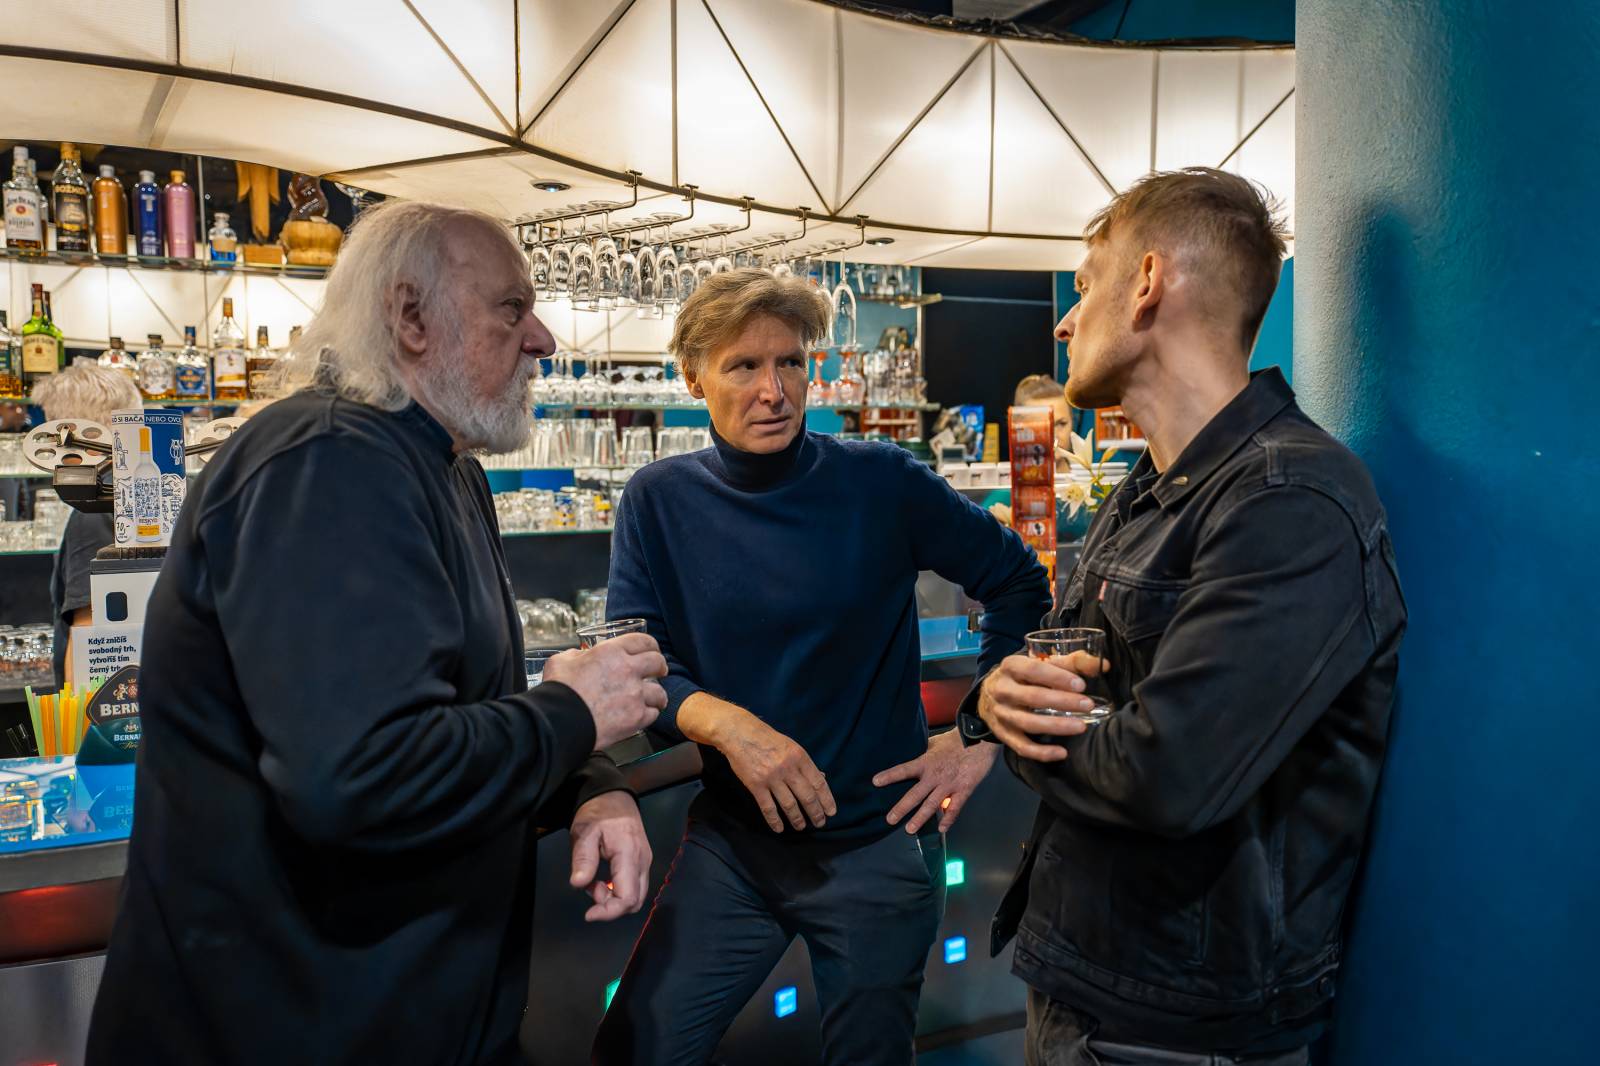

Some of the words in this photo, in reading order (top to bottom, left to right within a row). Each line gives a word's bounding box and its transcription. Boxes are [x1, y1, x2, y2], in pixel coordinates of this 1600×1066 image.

[125, 415, 143, 423] BAČA
[88, 637, 105, 646] Když
[106, 636, 127, 644] zničíš
[89, 646, 122, 654] svobodný
[89, 656, 116, 665] vytvoříš
[90, 666, 109, 674] černý
[100, 702, 139, 717] BERN
